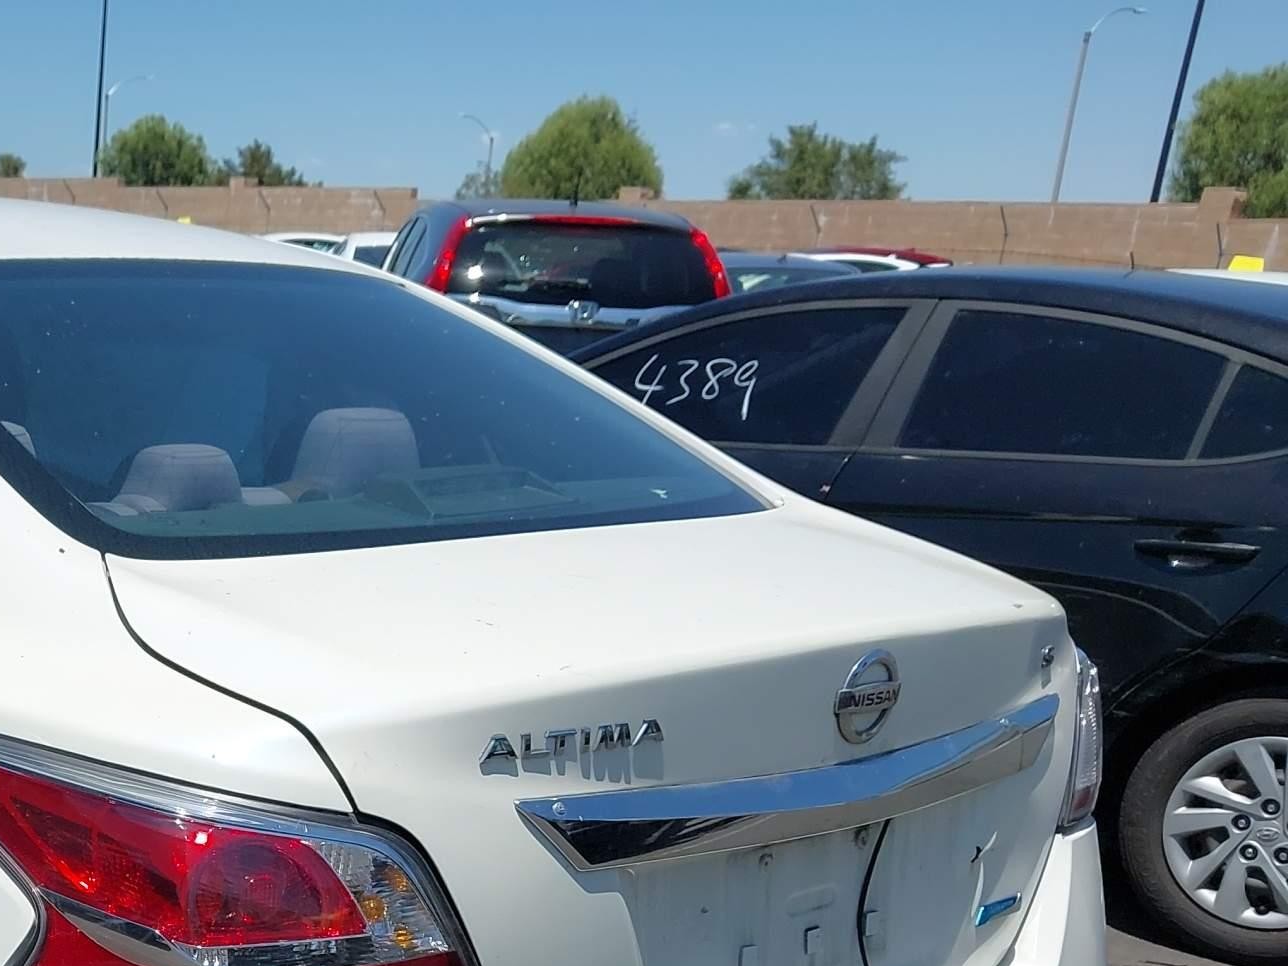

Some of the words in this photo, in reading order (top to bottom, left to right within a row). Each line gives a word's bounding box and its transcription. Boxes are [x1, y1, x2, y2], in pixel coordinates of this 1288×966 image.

[634, 353, 760, 421] 4389
[848, 687, 899, 709] NISSAN
[478, 718, 665, 764] ALTIMA
